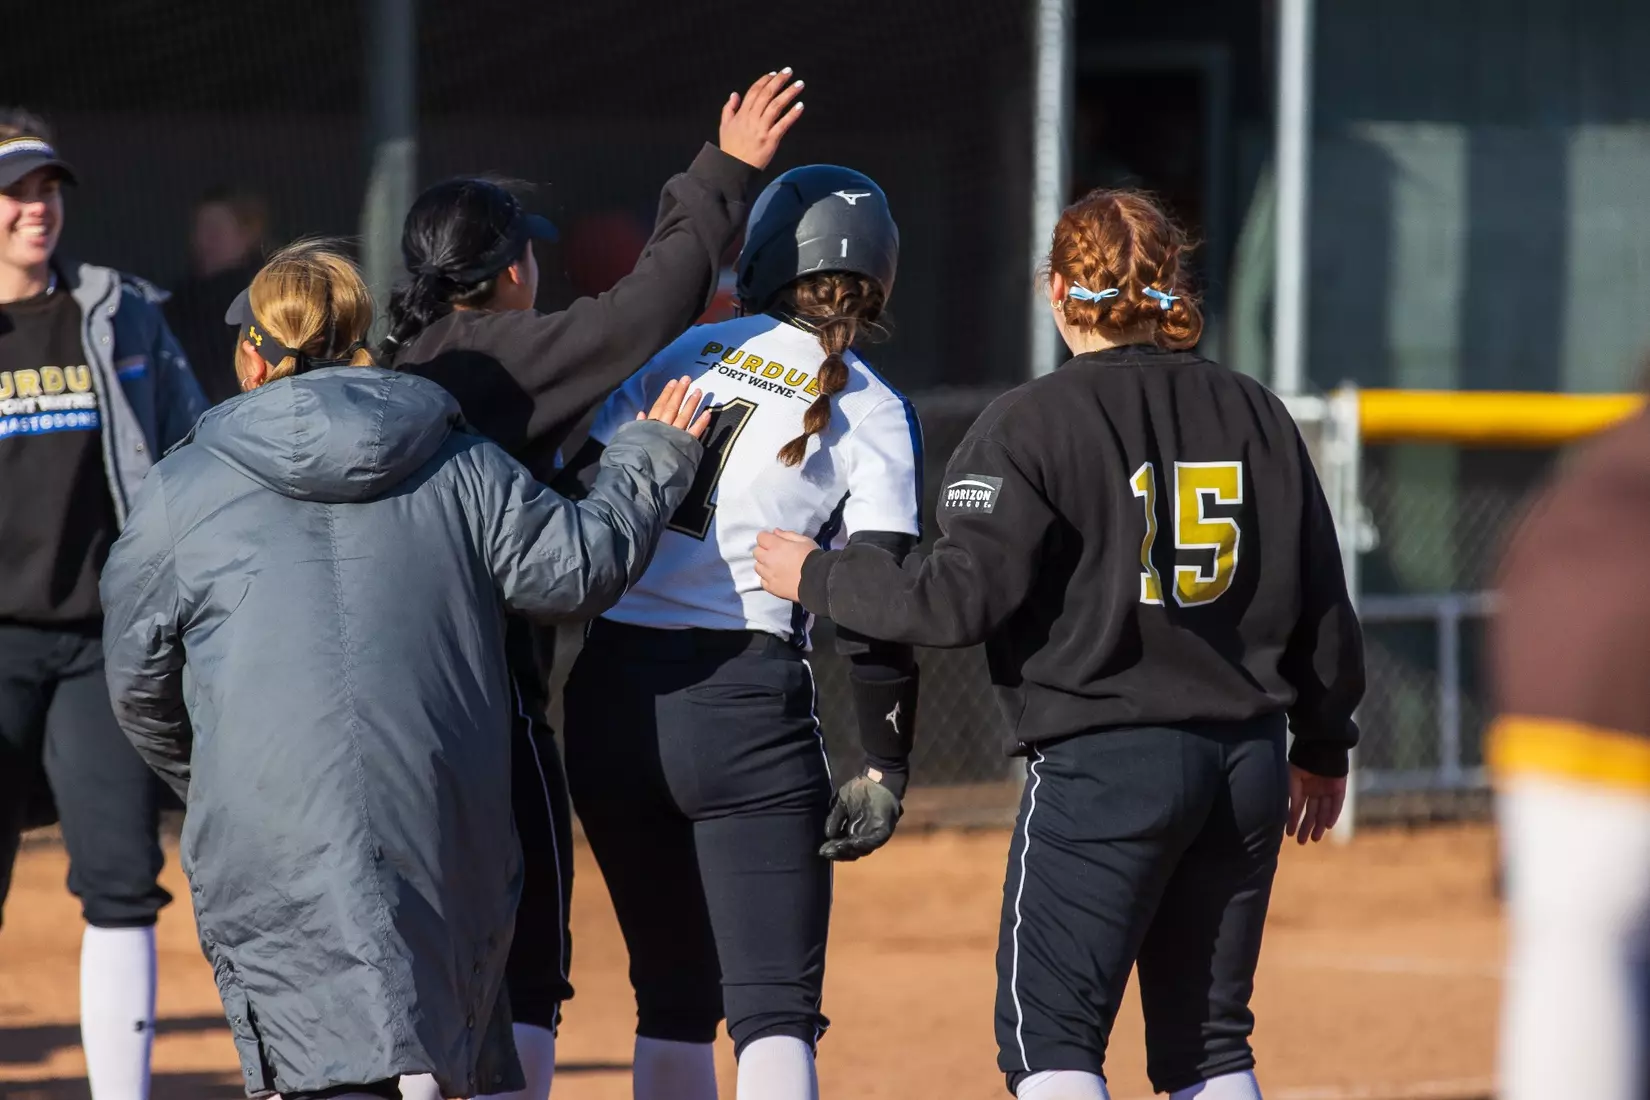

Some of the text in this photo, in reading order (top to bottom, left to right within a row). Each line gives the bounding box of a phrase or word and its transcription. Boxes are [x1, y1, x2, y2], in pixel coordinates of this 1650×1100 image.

[840, 238, 848, 258] 1
[700, 341, 819, 397] PURDUE
[709, 361, 796, 398] FORT WAYNE
[945, 500, 989, 508] LEAGUE
[947, 488, 992, 501] HORIZON
[1129, 461, 1243, 608] 15
